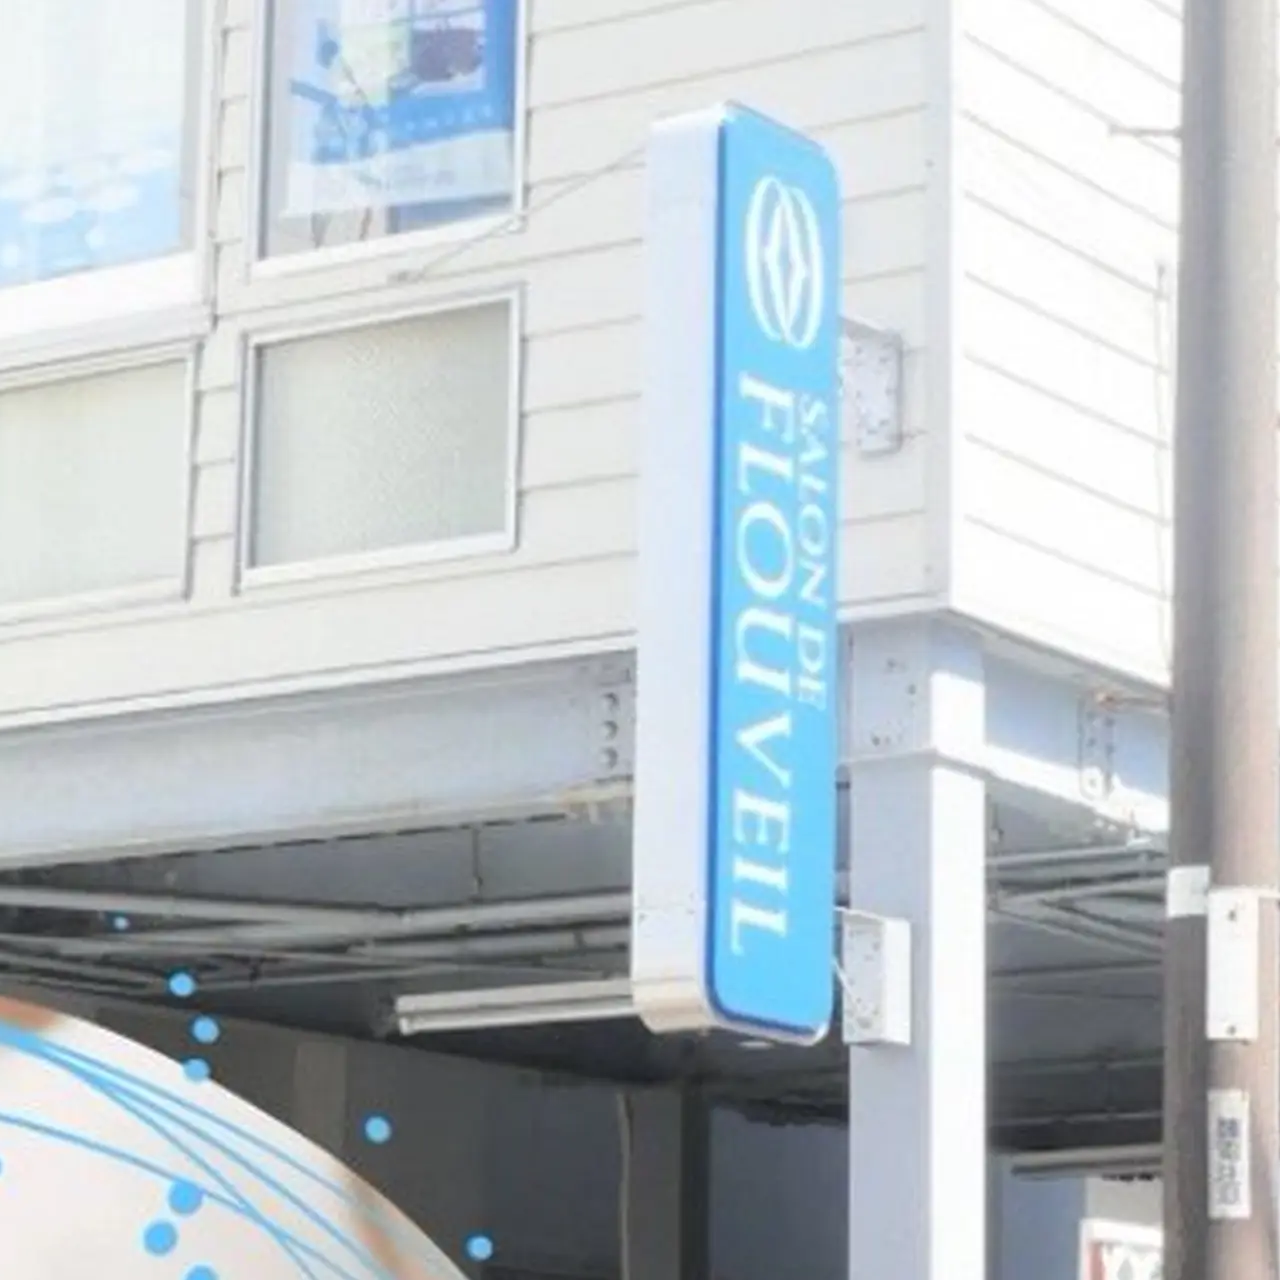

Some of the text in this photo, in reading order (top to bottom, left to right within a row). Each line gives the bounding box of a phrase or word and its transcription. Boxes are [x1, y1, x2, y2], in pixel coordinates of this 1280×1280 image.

[729, 371, 795, 958] FLOUVEIL
[796, 392, 828, 712] SALON DE
